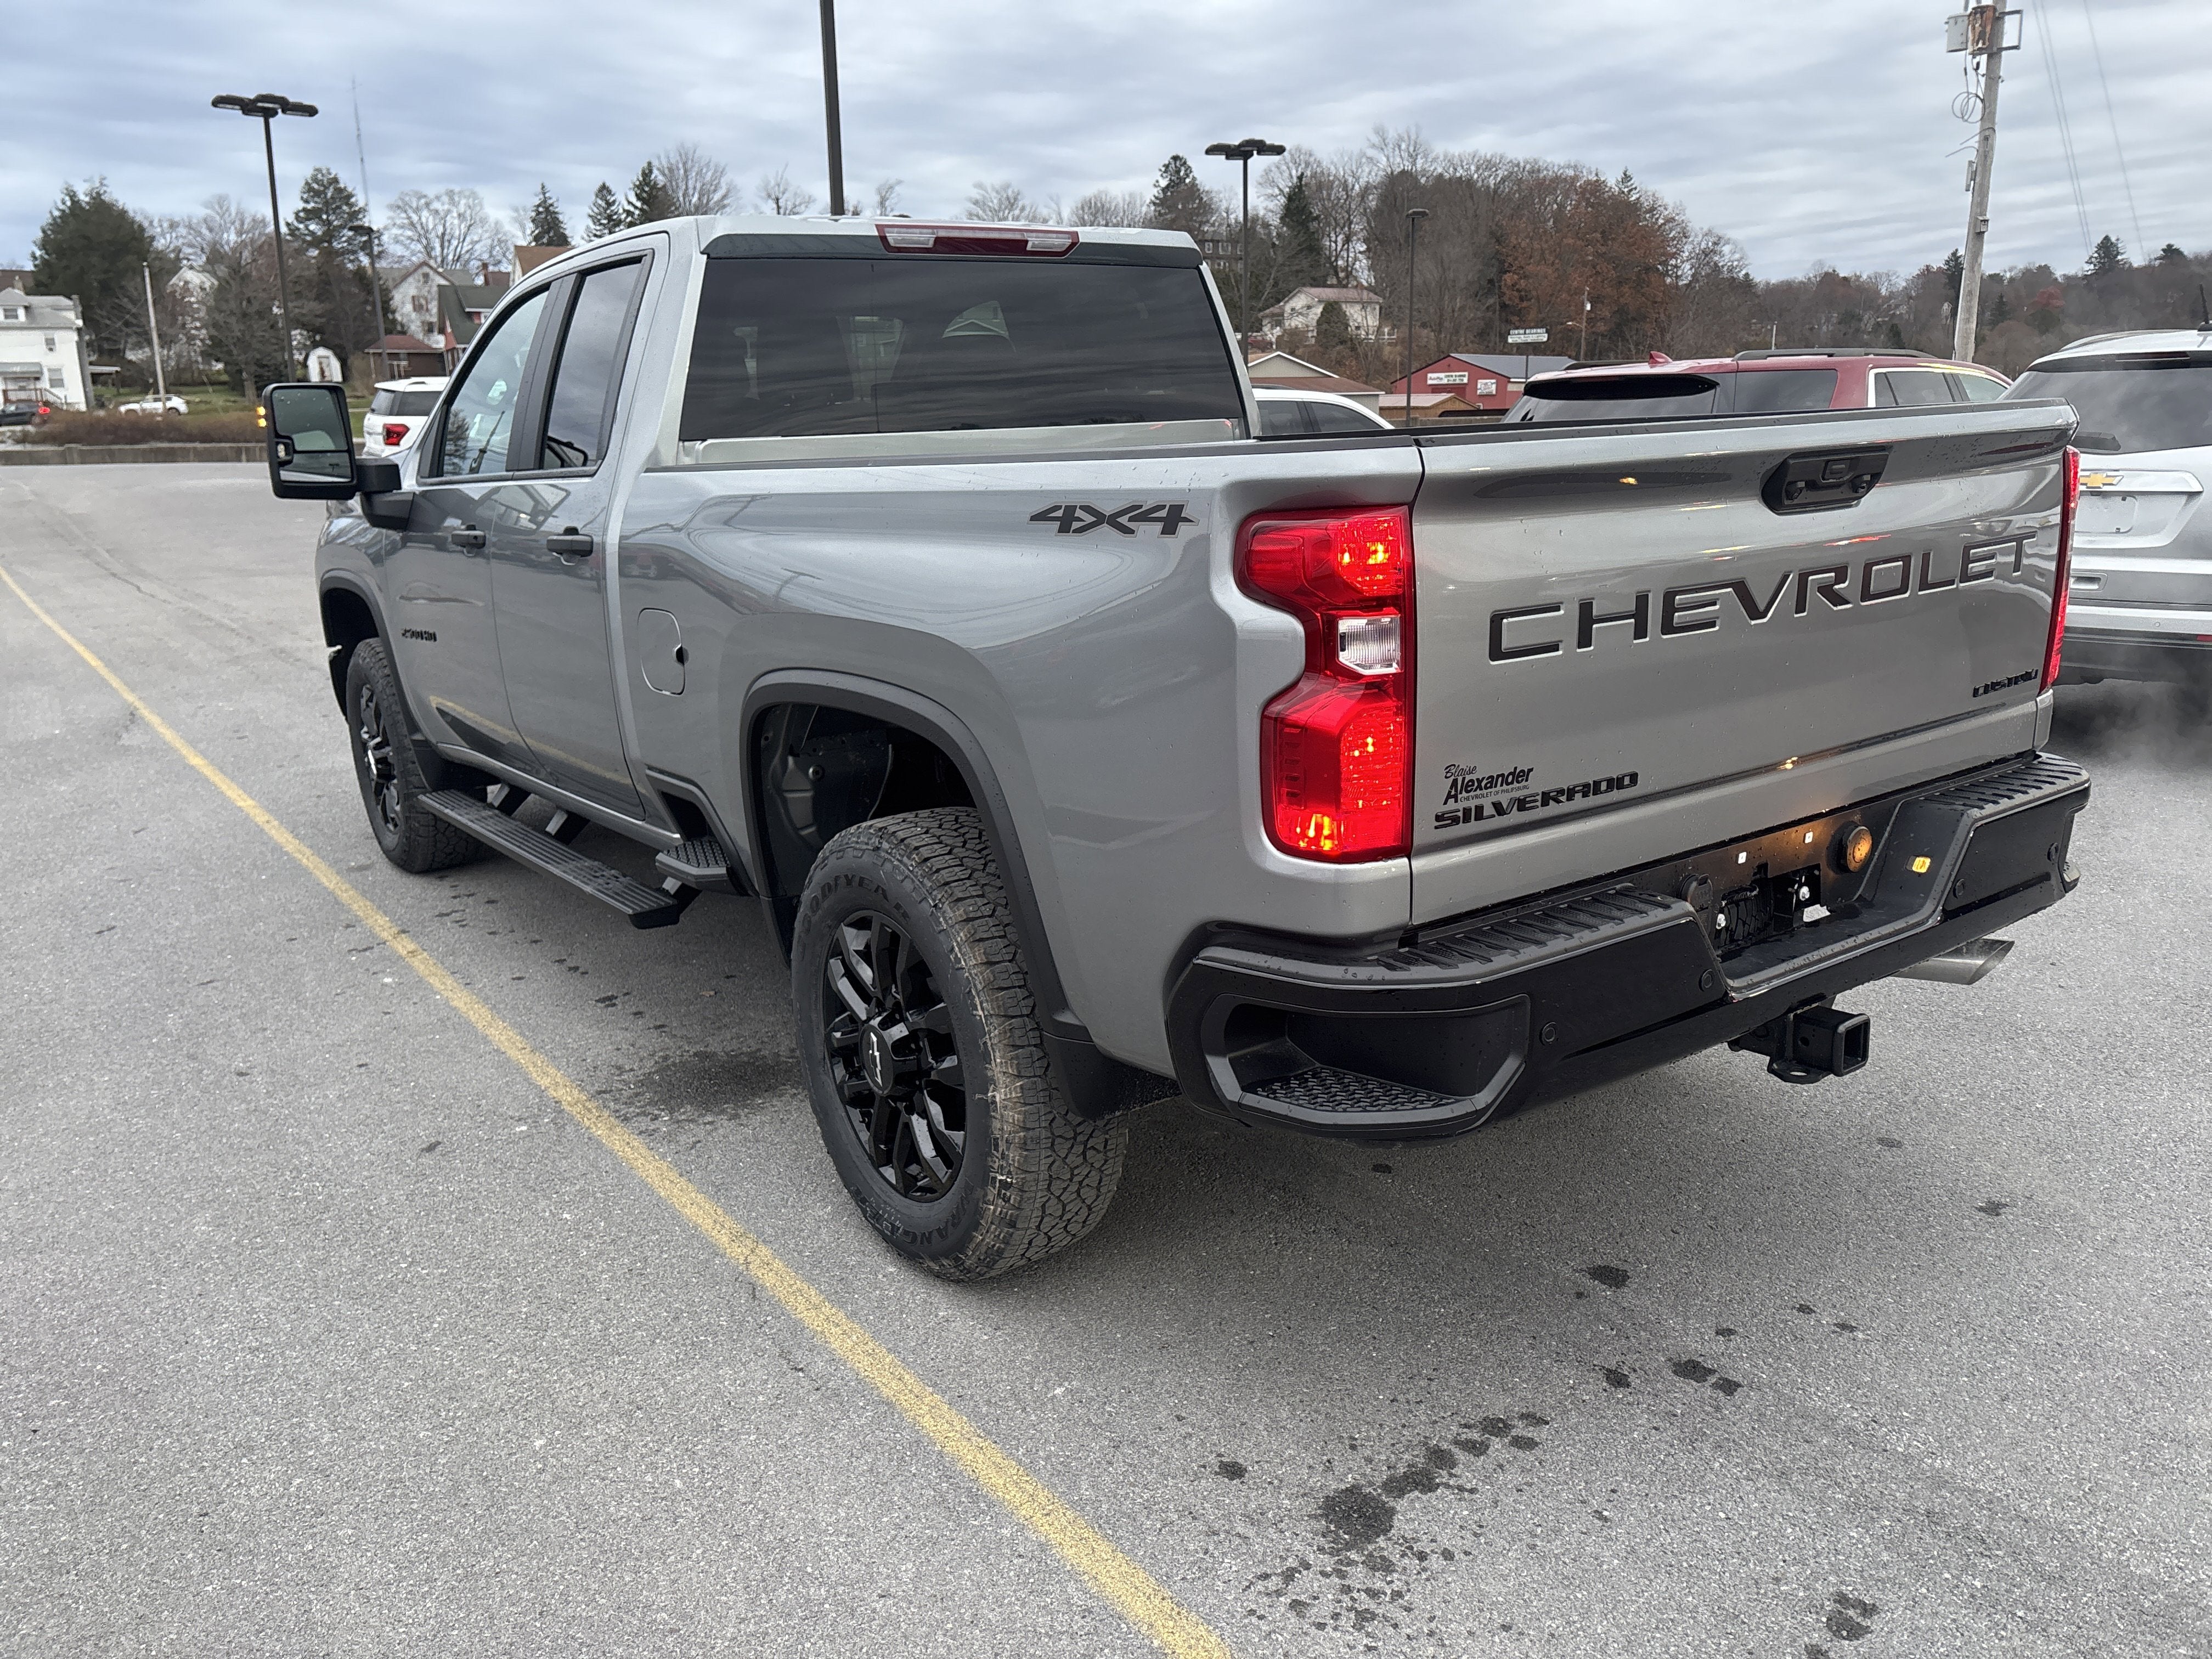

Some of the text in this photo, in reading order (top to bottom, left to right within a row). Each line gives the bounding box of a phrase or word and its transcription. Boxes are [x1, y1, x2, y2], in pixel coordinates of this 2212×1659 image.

[1489, 531, 2038, 664] CHEVROLET
[1442, 766, 1534, 805] Alexander
[1444, 764, 1477, 779] Blaise
[1434, 771, 1639, 830] SILVERADO
[1459, 791, 1493, 803] CHEVROLET
